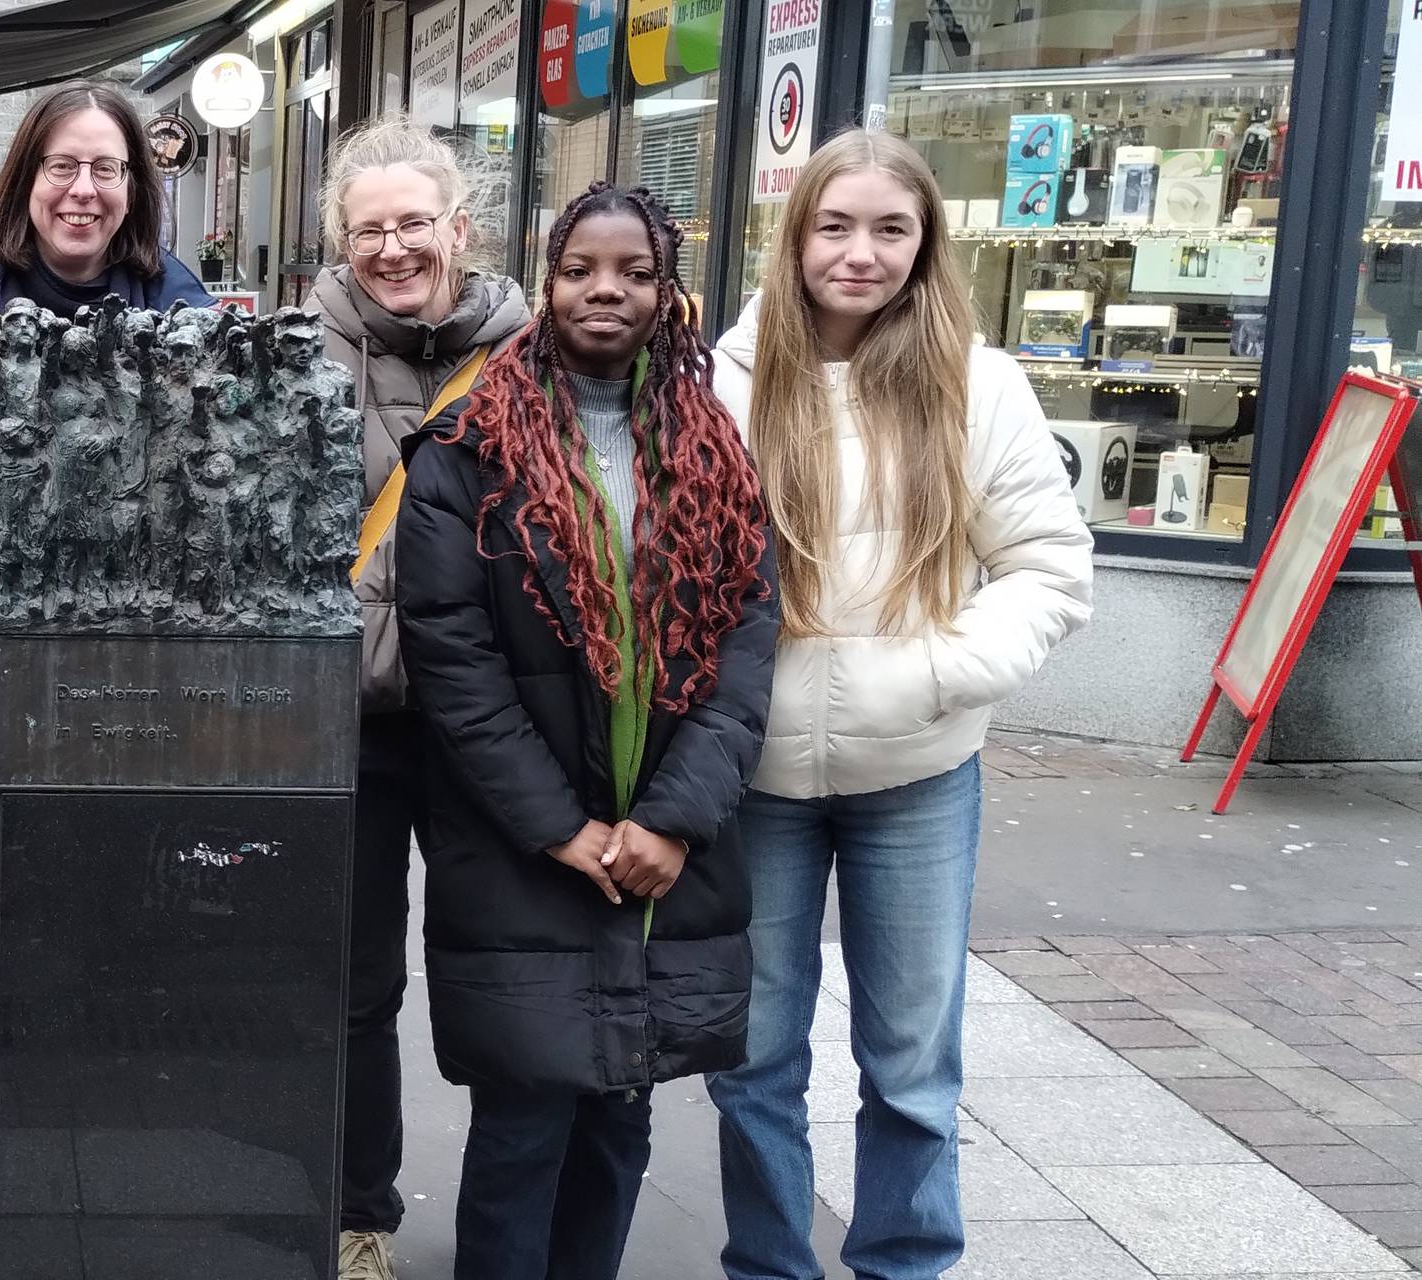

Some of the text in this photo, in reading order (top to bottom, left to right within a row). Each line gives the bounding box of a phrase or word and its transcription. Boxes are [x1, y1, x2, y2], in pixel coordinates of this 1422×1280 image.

[413, 32, 424, 56] AN-
[430, 7, 457, 43] VERKAUF
[631, 6, 669, 38] SICHERUNG
[769, 0, 820, 34] EXPRESS
[462, 19, 519, 74] EXPRESS REPARATUR
[543, 24, 570, 52] PANZER-
[767, 28, 818, 58] REPARATUREN
[462, 70, 485, 99] SCHNELL
[491, 49, 515, 80] EINFACH
[546, 57, 563, 83] GLAS
[758, 166, 803, 195] IN 30MI
[101, 684, 161, 702] Herren
[179, 685, 226, 702] Wort
[241, 686, 291, 702] bleibt
[56, 723, 72, 739] in
